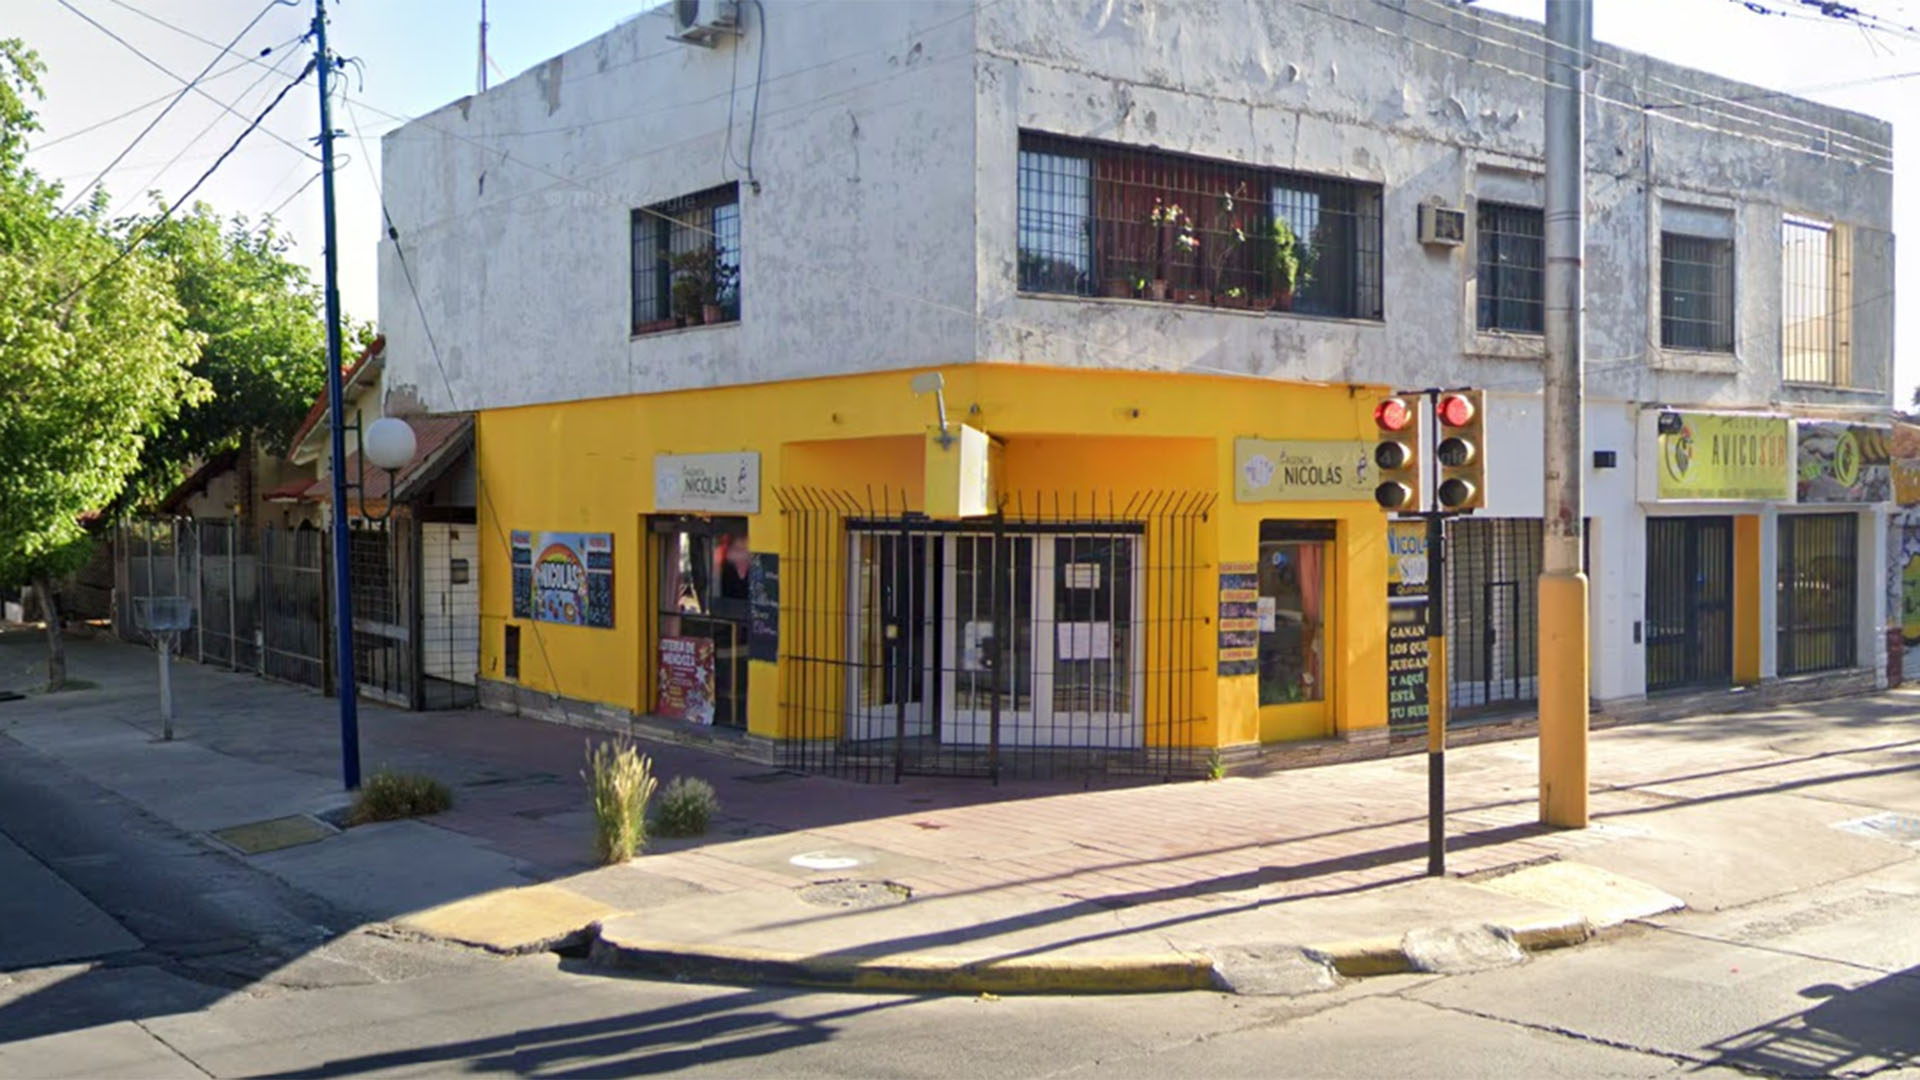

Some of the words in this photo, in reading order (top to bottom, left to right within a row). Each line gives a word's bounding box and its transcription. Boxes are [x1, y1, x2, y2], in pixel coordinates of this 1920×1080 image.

[1712, 434, 1786, 467] AVICOSUR
[1390, 625, 1426, 639] GANAN
[1390, 642, 1408, 656] LOS
[1389, 656, 1429, 672] JUEGAN
[1389, 675, 1397, 687] Y
[1390, 706, 1406, 720] TU
[1407, 704, 1429, 719] SUE
